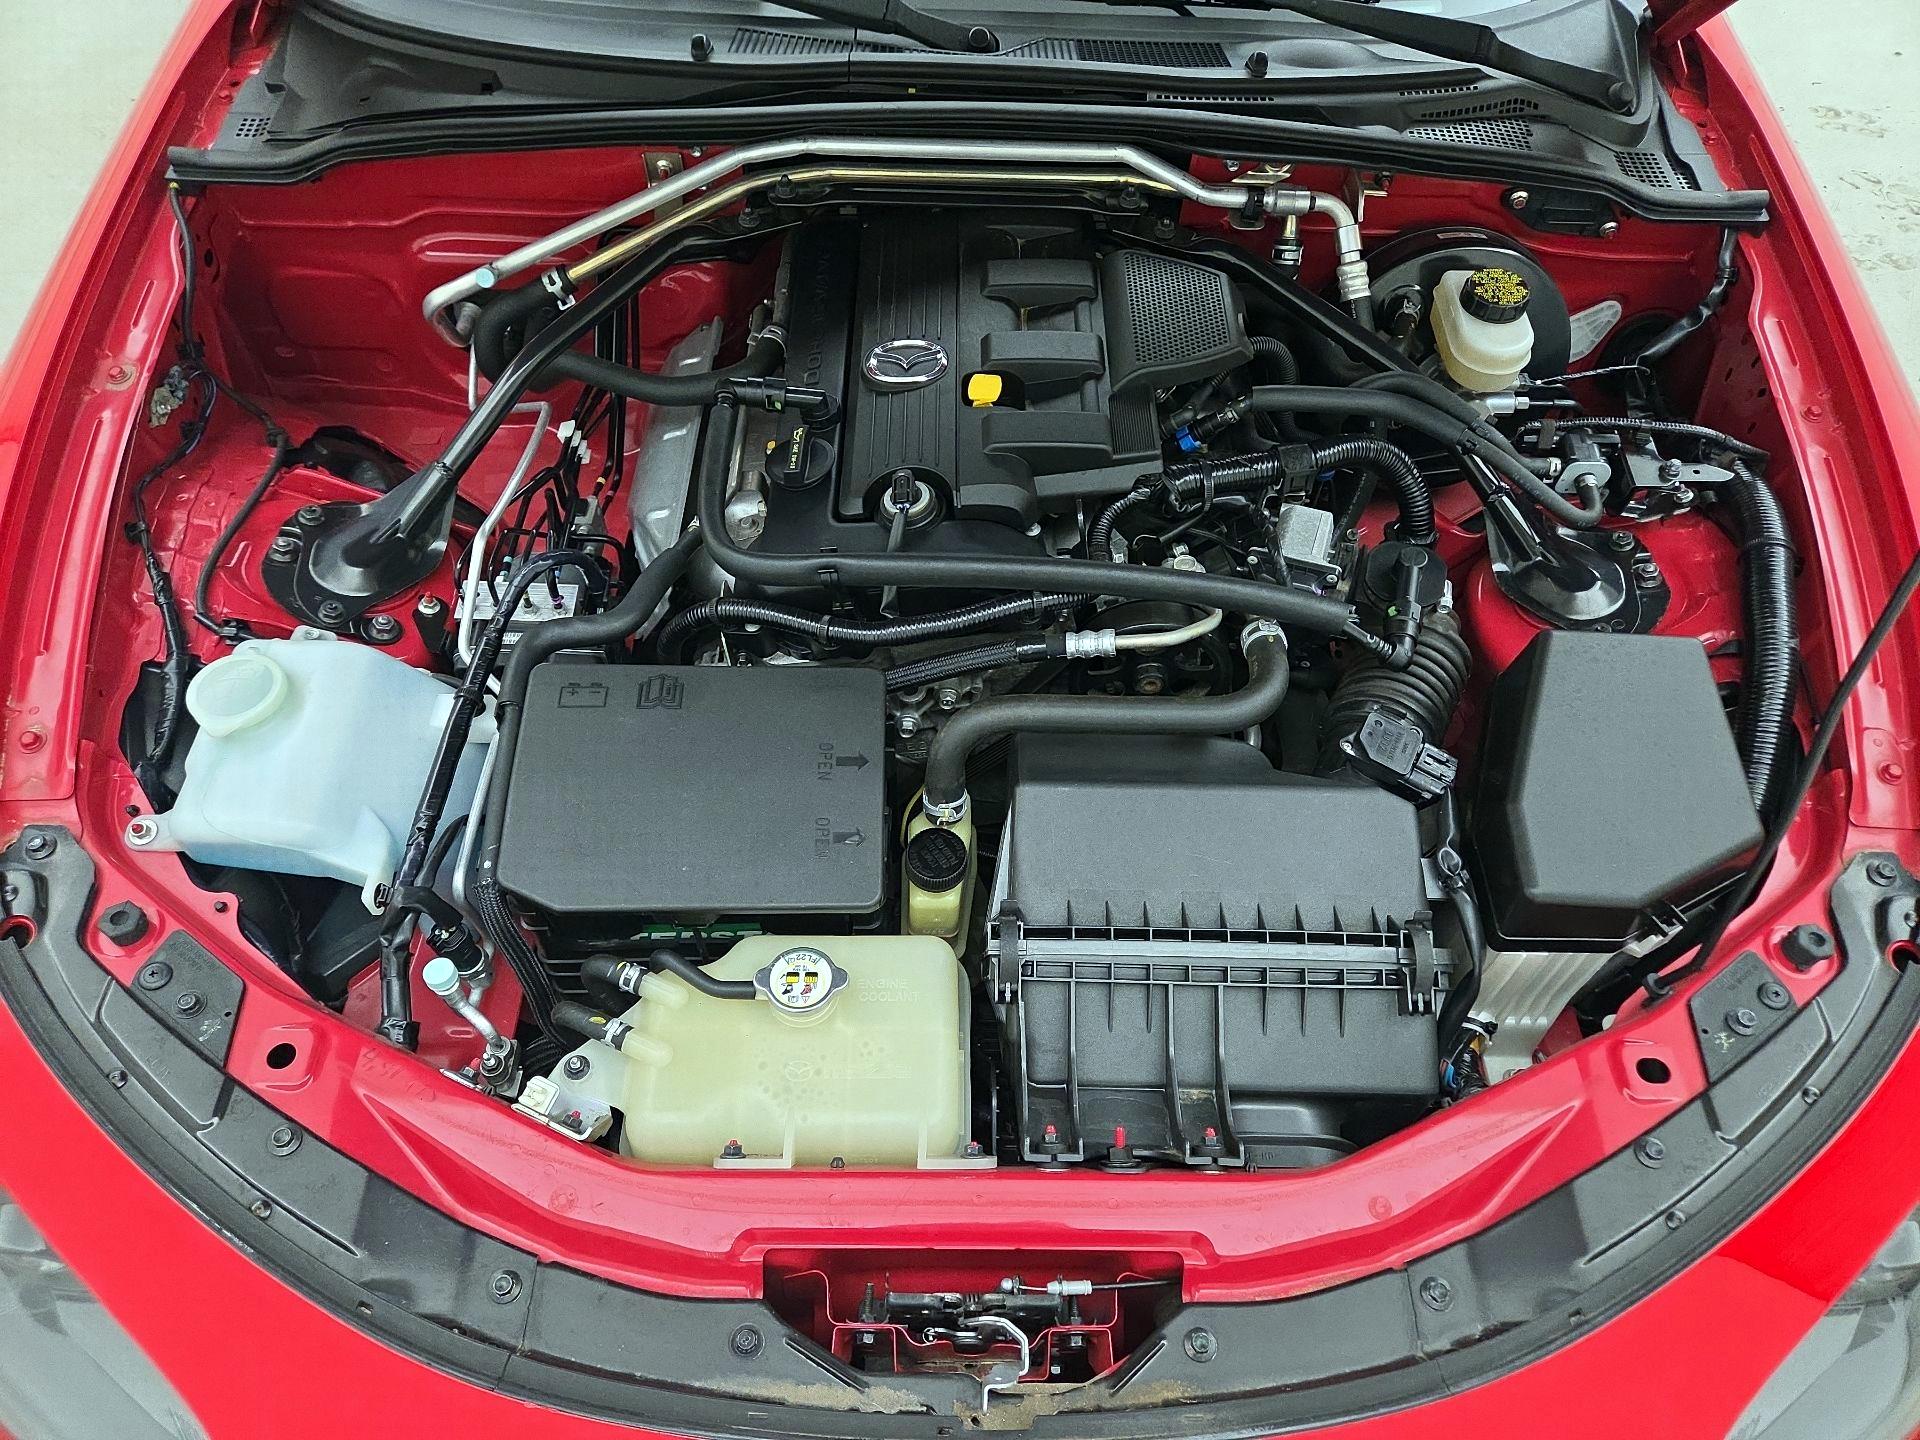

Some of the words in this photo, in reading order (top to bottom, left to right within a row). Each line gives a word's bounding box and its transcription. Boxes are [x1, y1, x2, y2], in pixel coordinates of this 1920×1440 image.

[817, 742, 835, 782] OPEN
[814, 816, 831, 860] OPEN
[795, 953, 818, 964] FL22
[857, 978, 910, 989] ENGINE
[858, 991, 920, 1002] COOLANT
